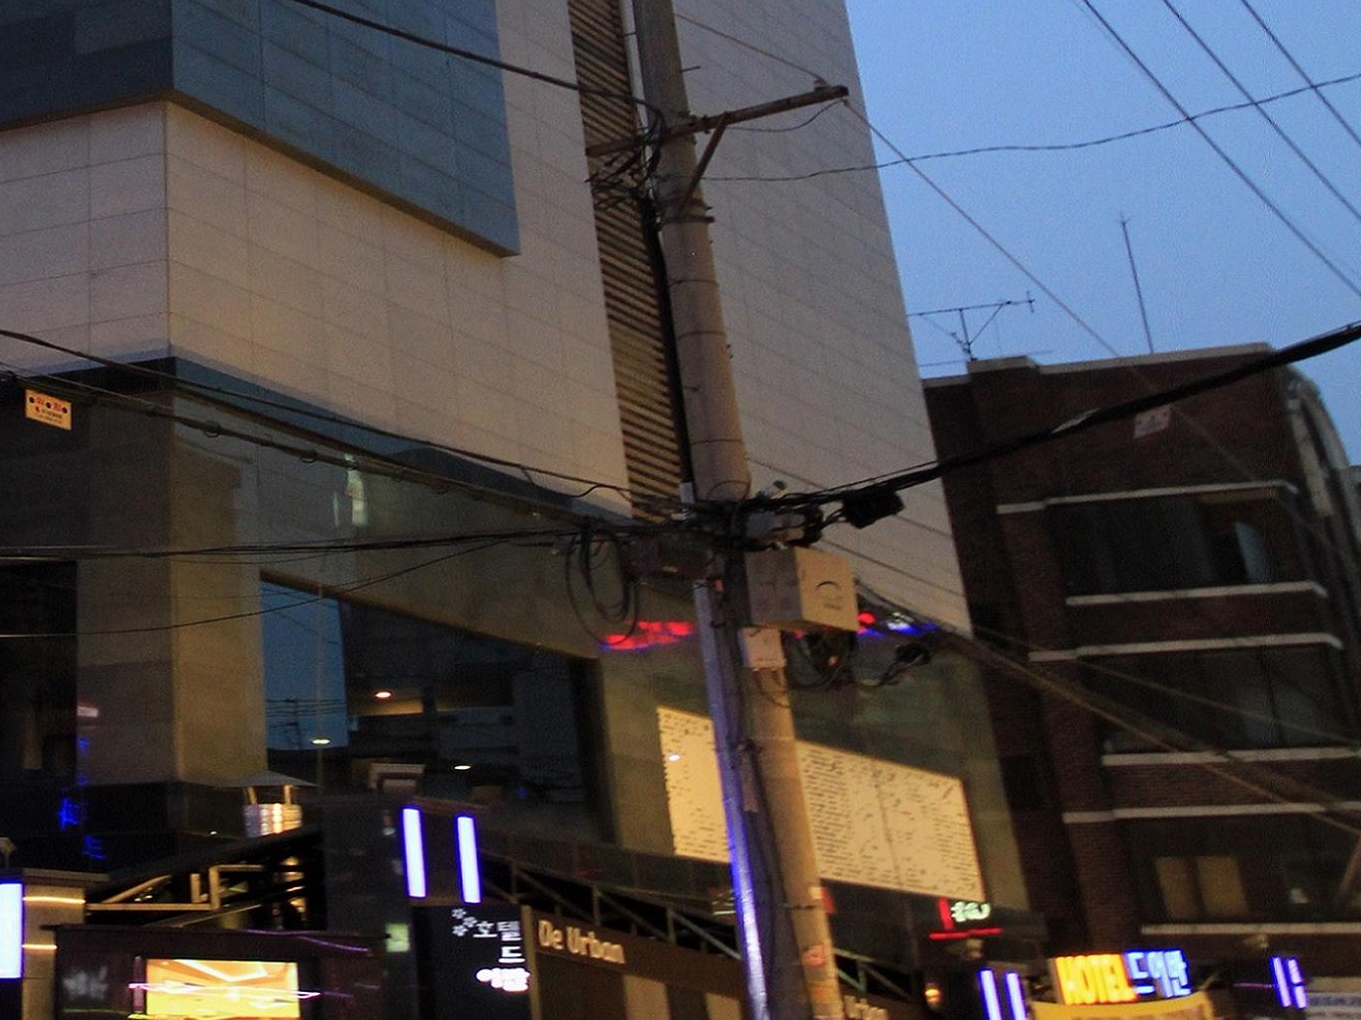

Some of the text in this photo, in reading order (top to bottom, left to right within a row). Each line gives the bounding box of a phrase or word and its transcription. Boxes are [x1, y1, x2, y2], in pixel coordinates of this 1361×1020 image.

[538, 919, 627, 965] De Urban
[1054, 952, 1138, 1006] HOTEL
